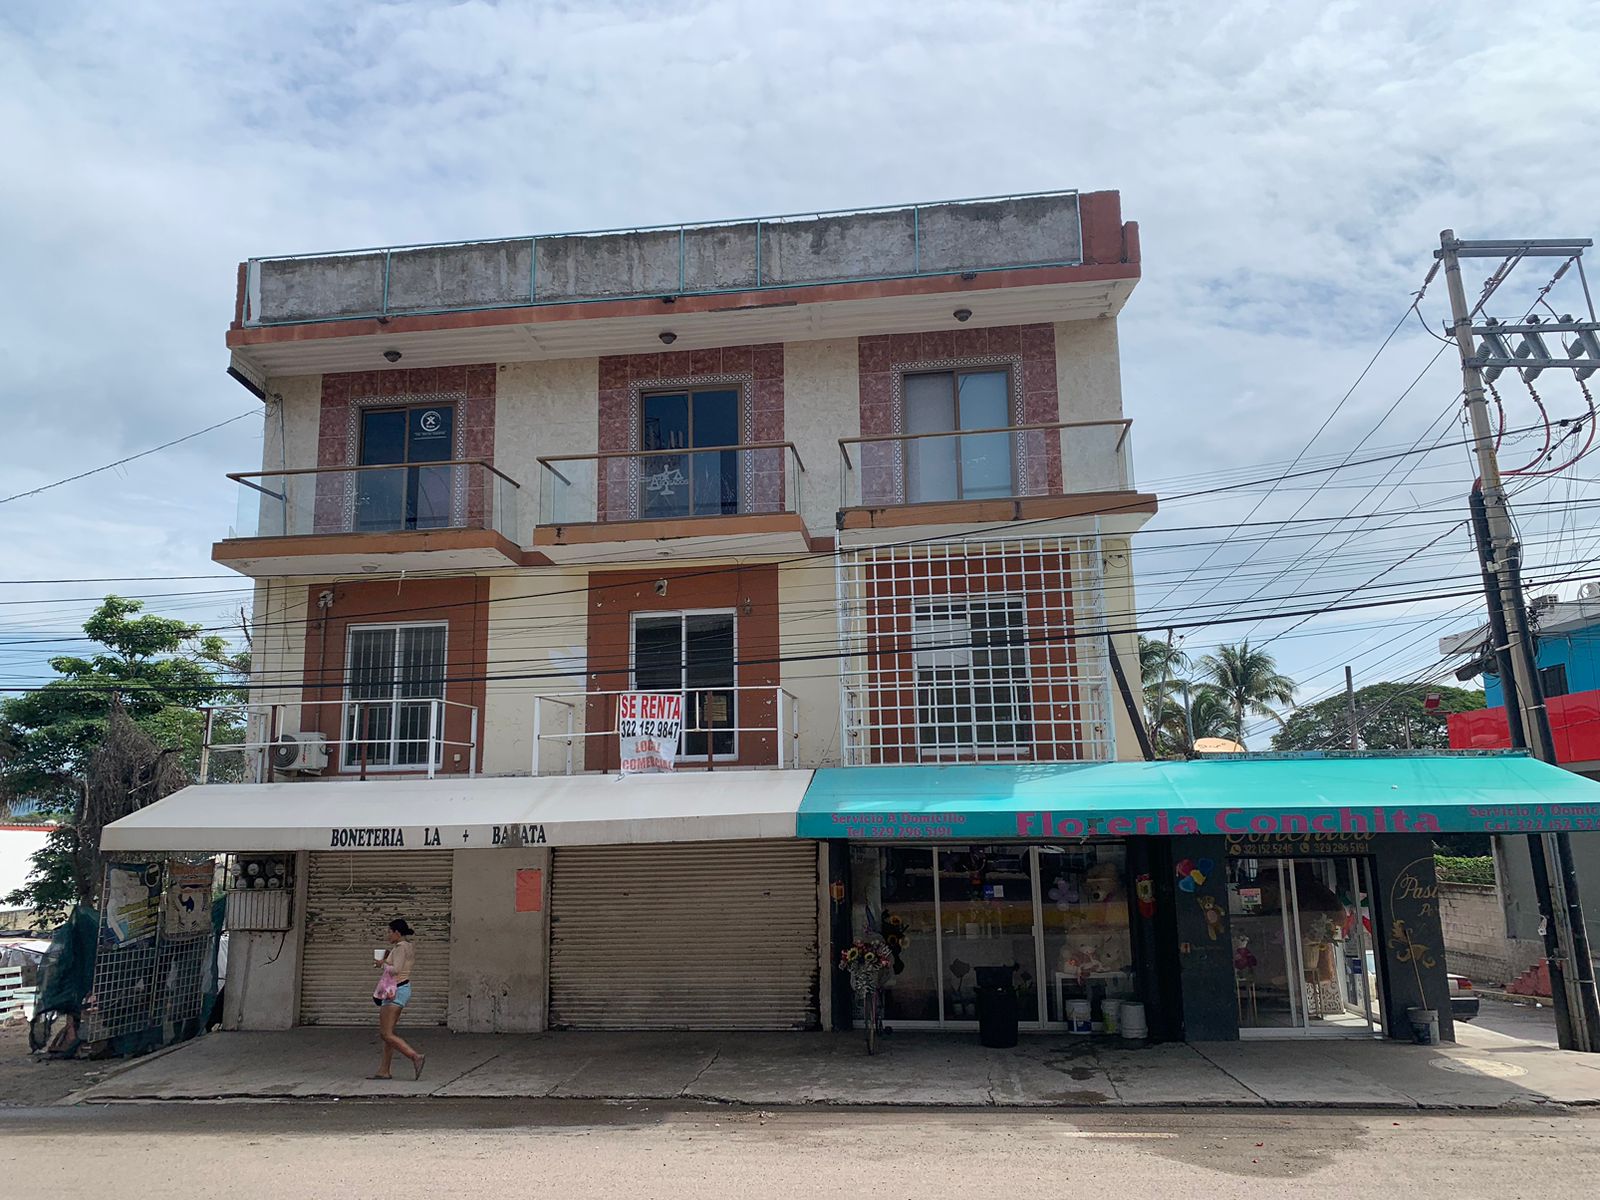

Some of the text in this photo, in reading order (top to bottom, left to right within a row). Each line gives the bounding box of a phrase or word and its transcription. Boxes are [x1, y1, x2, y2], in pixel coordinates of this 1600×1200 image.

[621, 695, 681, 720] SE RENTA
[621, 720, 679, 739] 322 152 9847
[831, 813, 883, 825] Servicio
[886, 813, 897, 824] A
[1535, 805, 1545, 816] A
[1016, 806, 1441, 836] Floreria Conchita
[330, 828, 404, 847] BONETERIA
[424, 827, 441, 846] LA
